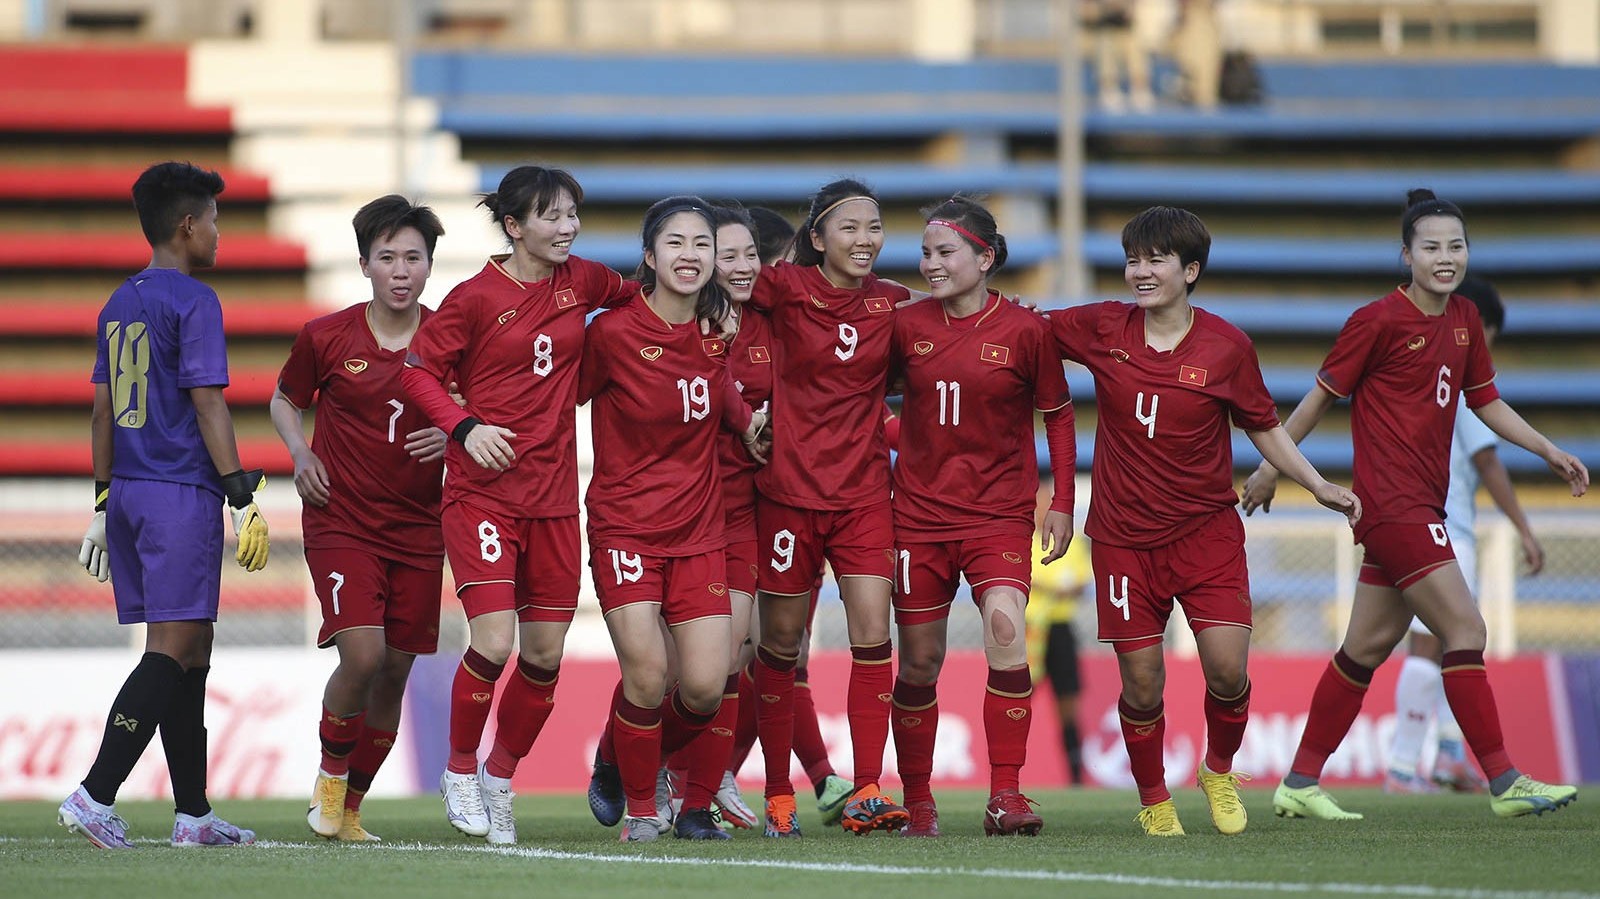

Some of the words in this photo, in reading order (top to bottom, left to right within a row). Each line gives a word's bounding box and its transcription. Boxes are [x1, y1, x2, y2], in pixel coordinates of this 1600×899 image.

[534, 334, 553, 377] 8
[835, 323, 859, 362] 9
[106, 321, 150, 428] 18
[1437, 365, 1451, 408] 6
[386, 399, 403, 443] 7
[677, 376, 710, 422] 19
[937, 380, 961, 427] 11
[1135, 391, 1159, 439] 4
[478, 520, 503, 563] 8
[771, 529, 796, 573] 9
[608, 548, 644, 586] 19
[328, 571, 345, 616] 7
[1110, 575, 1131, 621] 4
